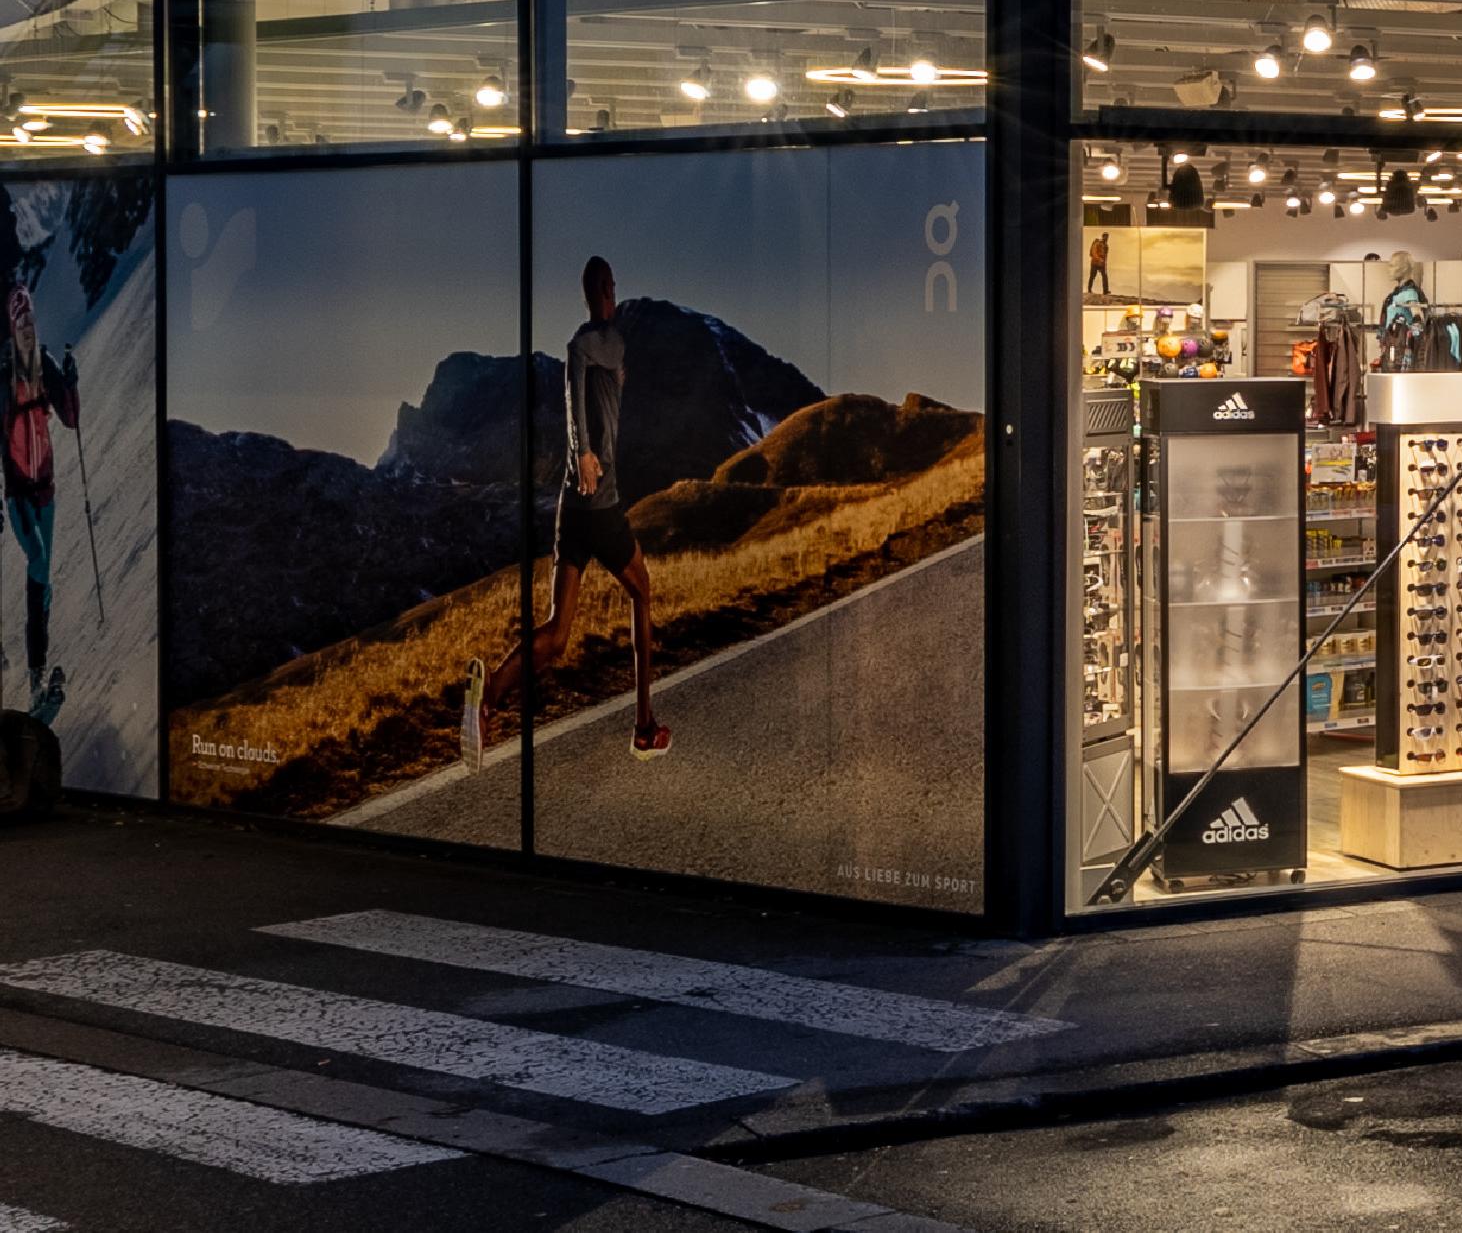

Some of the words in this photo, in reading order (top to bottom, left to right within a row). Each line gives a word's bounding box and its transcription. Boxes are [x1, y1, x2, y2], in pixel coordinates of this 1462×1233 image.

[192, 734, 217, 756] Run
[219, 743, 235, 759] on
[1202, 824, 1270, 844] adidas
[837, 862, 860, 880] AUS
[864, 867, 902, 884] LIEBE
[905, 871, 930, 889] ZUM
[934, 876, 976, 895] SPORT
